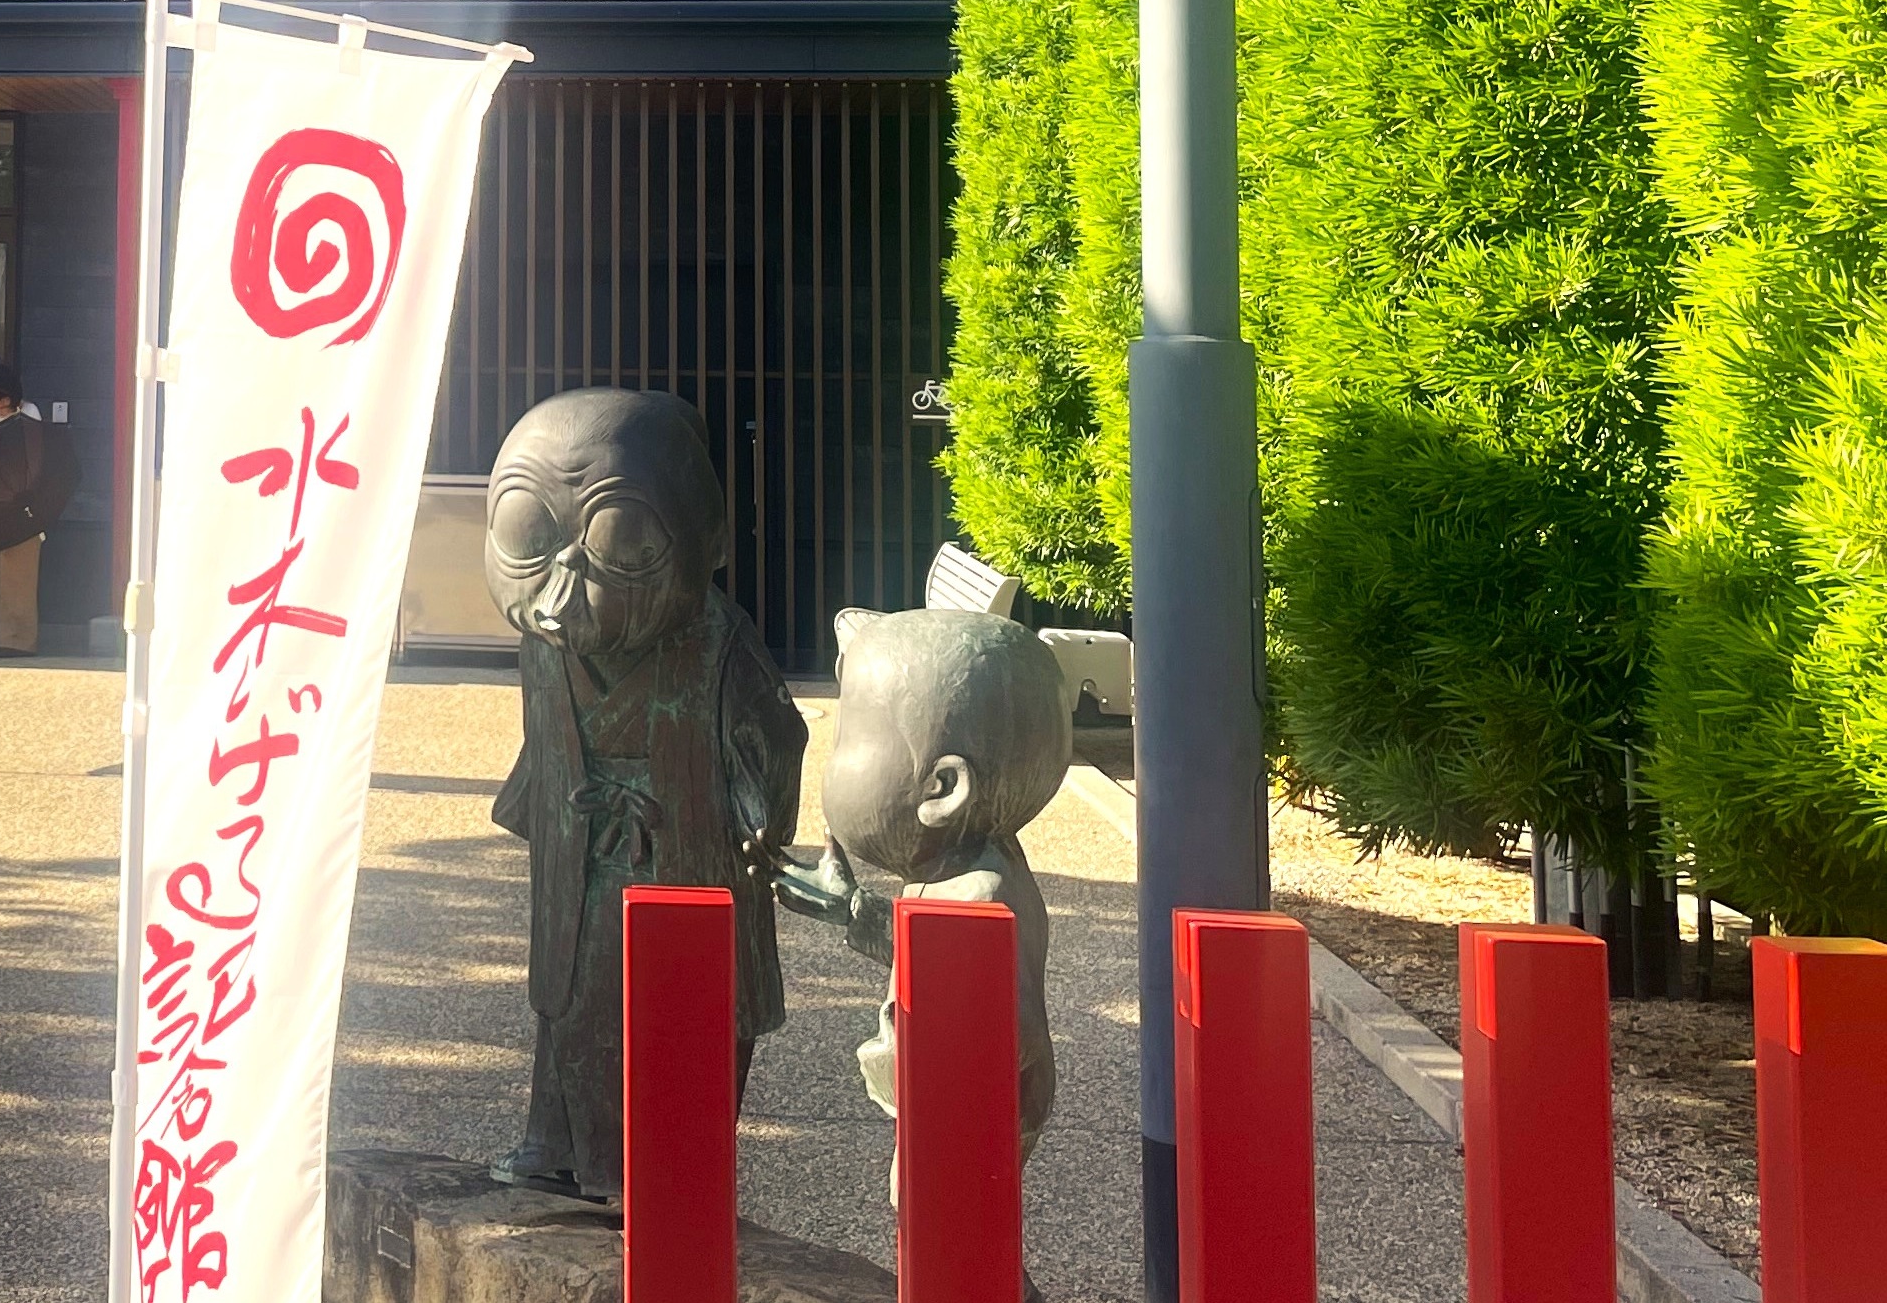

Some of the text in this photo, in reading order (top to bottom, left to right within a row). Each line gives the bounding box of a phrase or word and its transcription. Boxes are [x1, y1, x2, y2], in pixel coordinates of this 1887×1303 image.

[134, 407, 360, 1303] 水木しげる記念館
